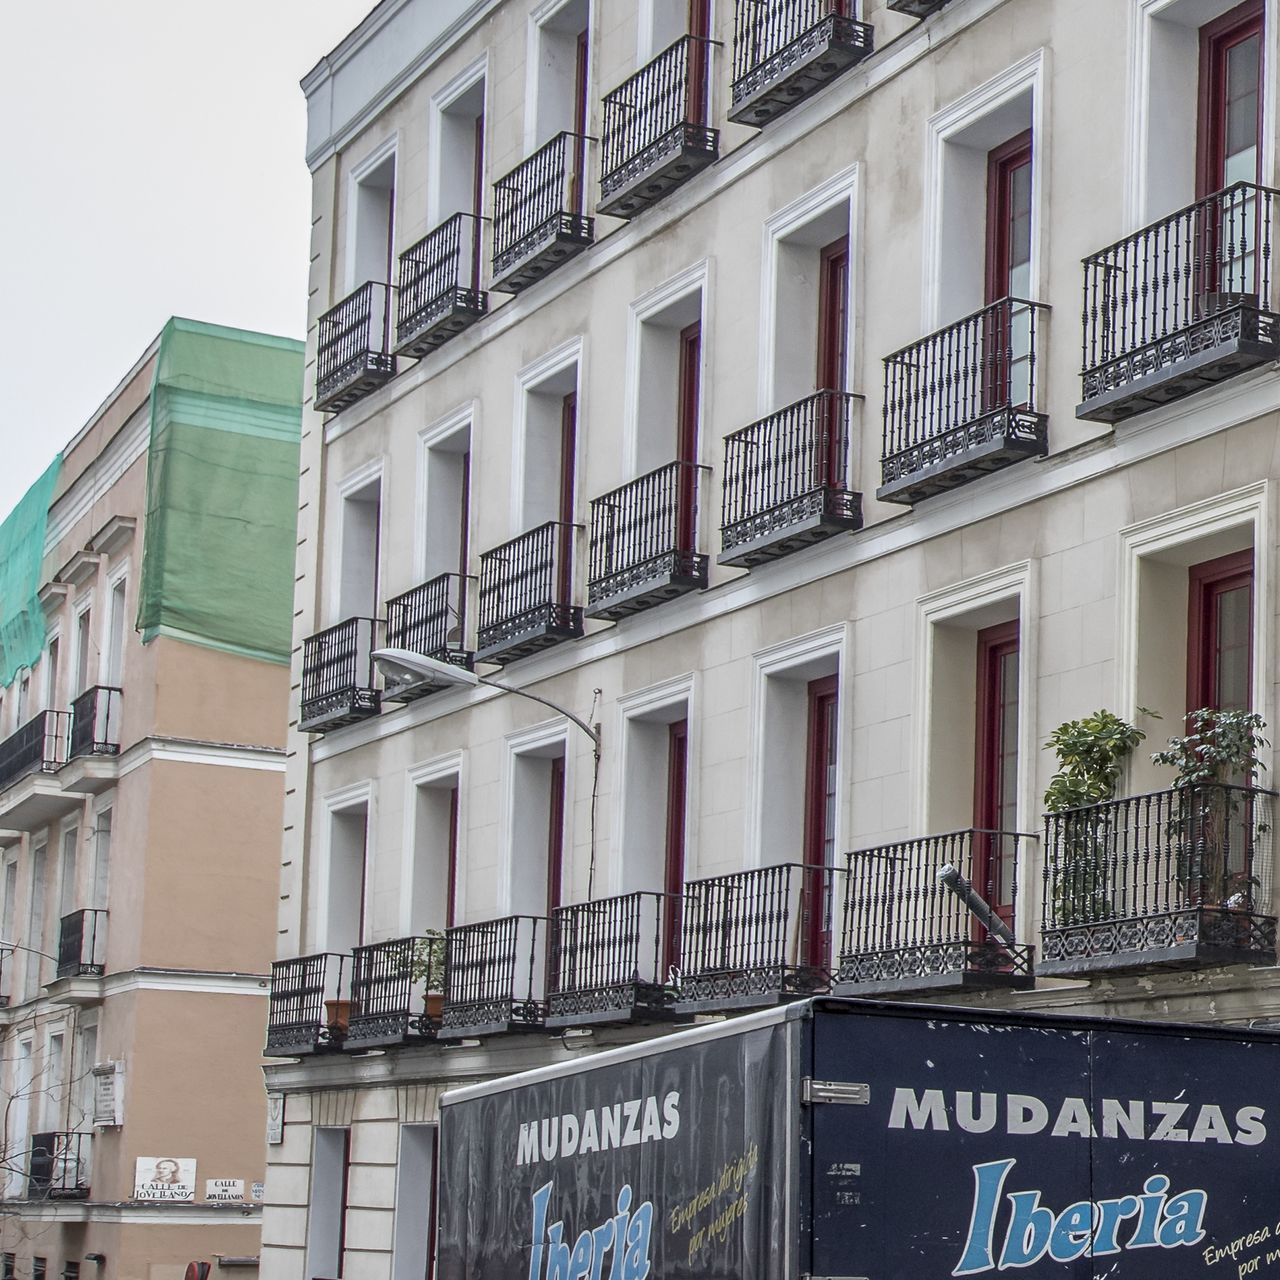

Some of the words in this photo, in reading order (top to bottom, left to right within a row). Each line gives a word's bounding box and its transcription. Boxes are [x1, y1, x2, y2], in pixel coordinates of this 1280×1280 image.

[516, 1091, 680, 1166] MUDANZAS
[887, 1087, 1267, 1146] MUDANZAS
[141, 1182, 174, 1191] CALLE
[214, 1180, 237, 1188] CALLE
[670, 1181, 716, 1234] Empresa
[718, 1141, 758, 1193] dirigida
[951, 1157, 1208, 1278] Iberia
[528, 1180, 653, 1280] Iberia
[689, 1227, 706, 1267] por
[708, 1192, 749, 1242] mujeres
[1202, 1226, 1271, 1266] Empresa
[1238, 1255, 1261, 1280] por
